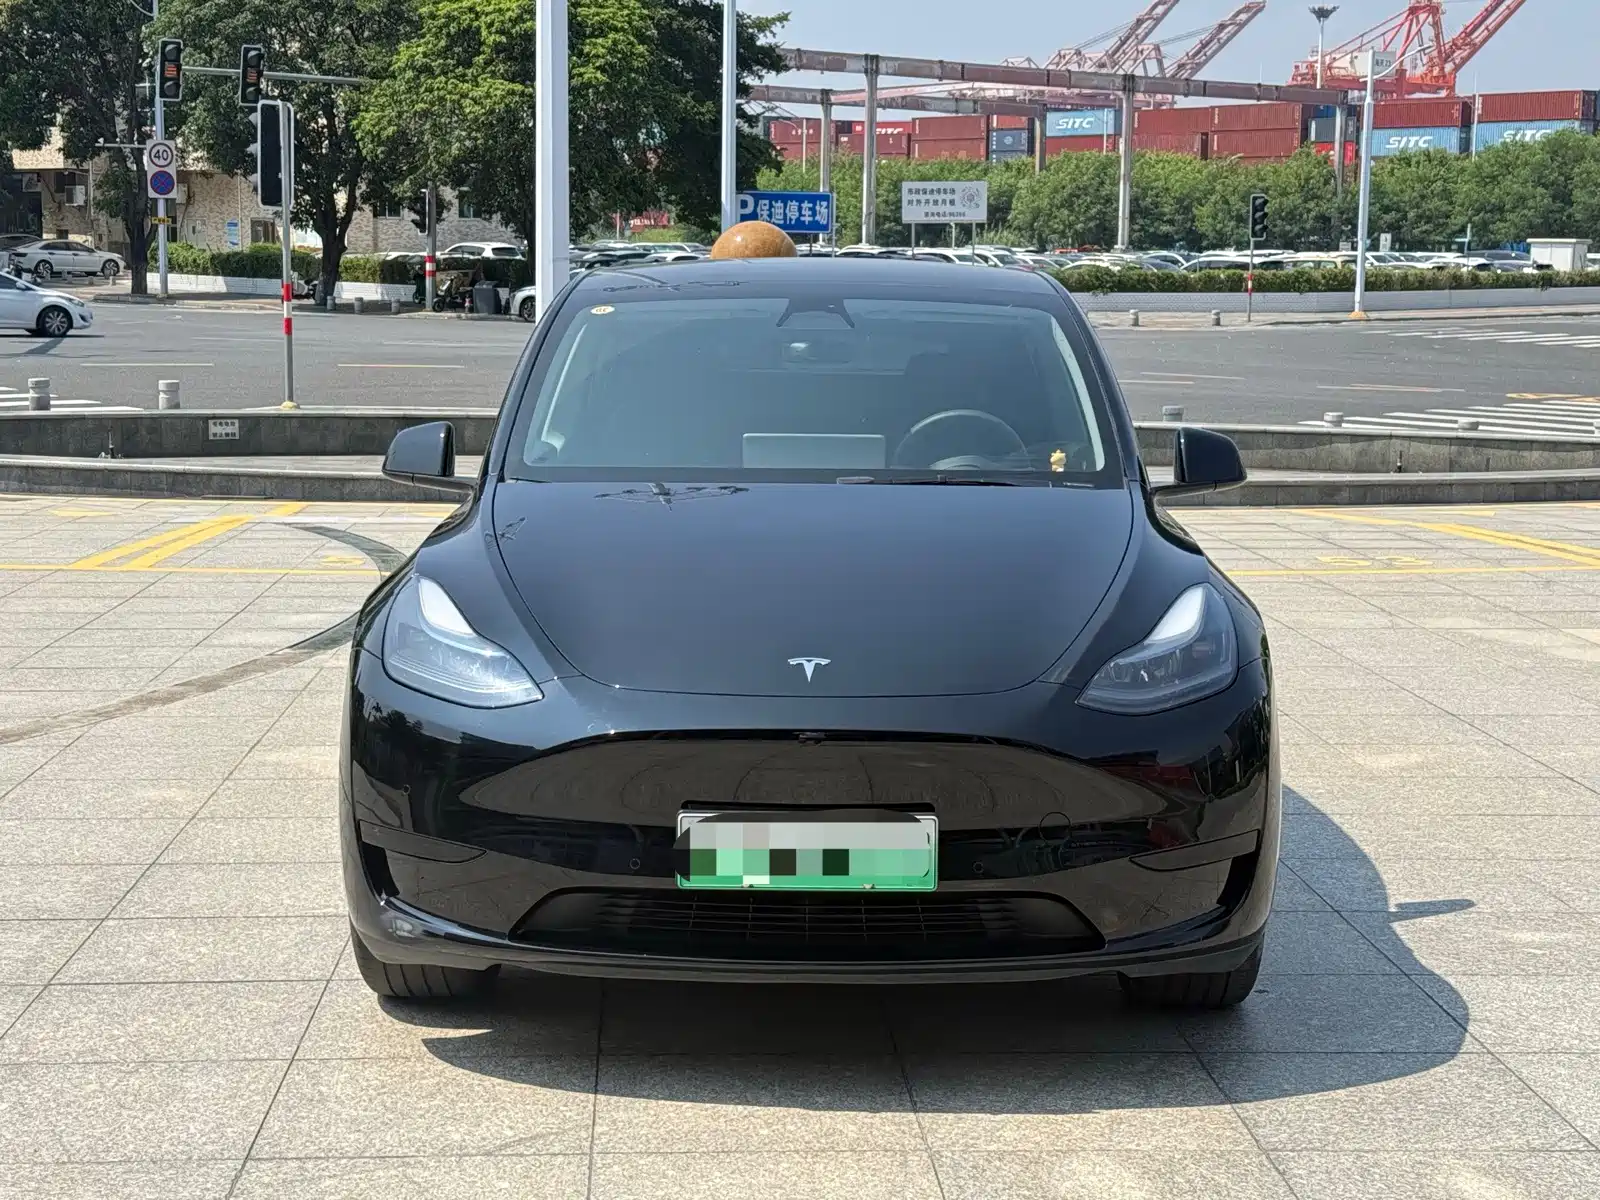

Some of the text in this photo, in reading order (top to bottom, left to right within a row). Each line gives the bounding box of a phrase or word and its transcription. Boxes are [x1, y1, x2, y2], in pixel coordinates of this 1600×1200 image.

[1055, 117, 1095, 129] SITC
[1385, 136, 1433, 149] SITC
[153, 149, 169, 161] 40
[907, 187, 956, 196] 市政保迪停车场
[756, 199, 828, 225] 保迪停车场
